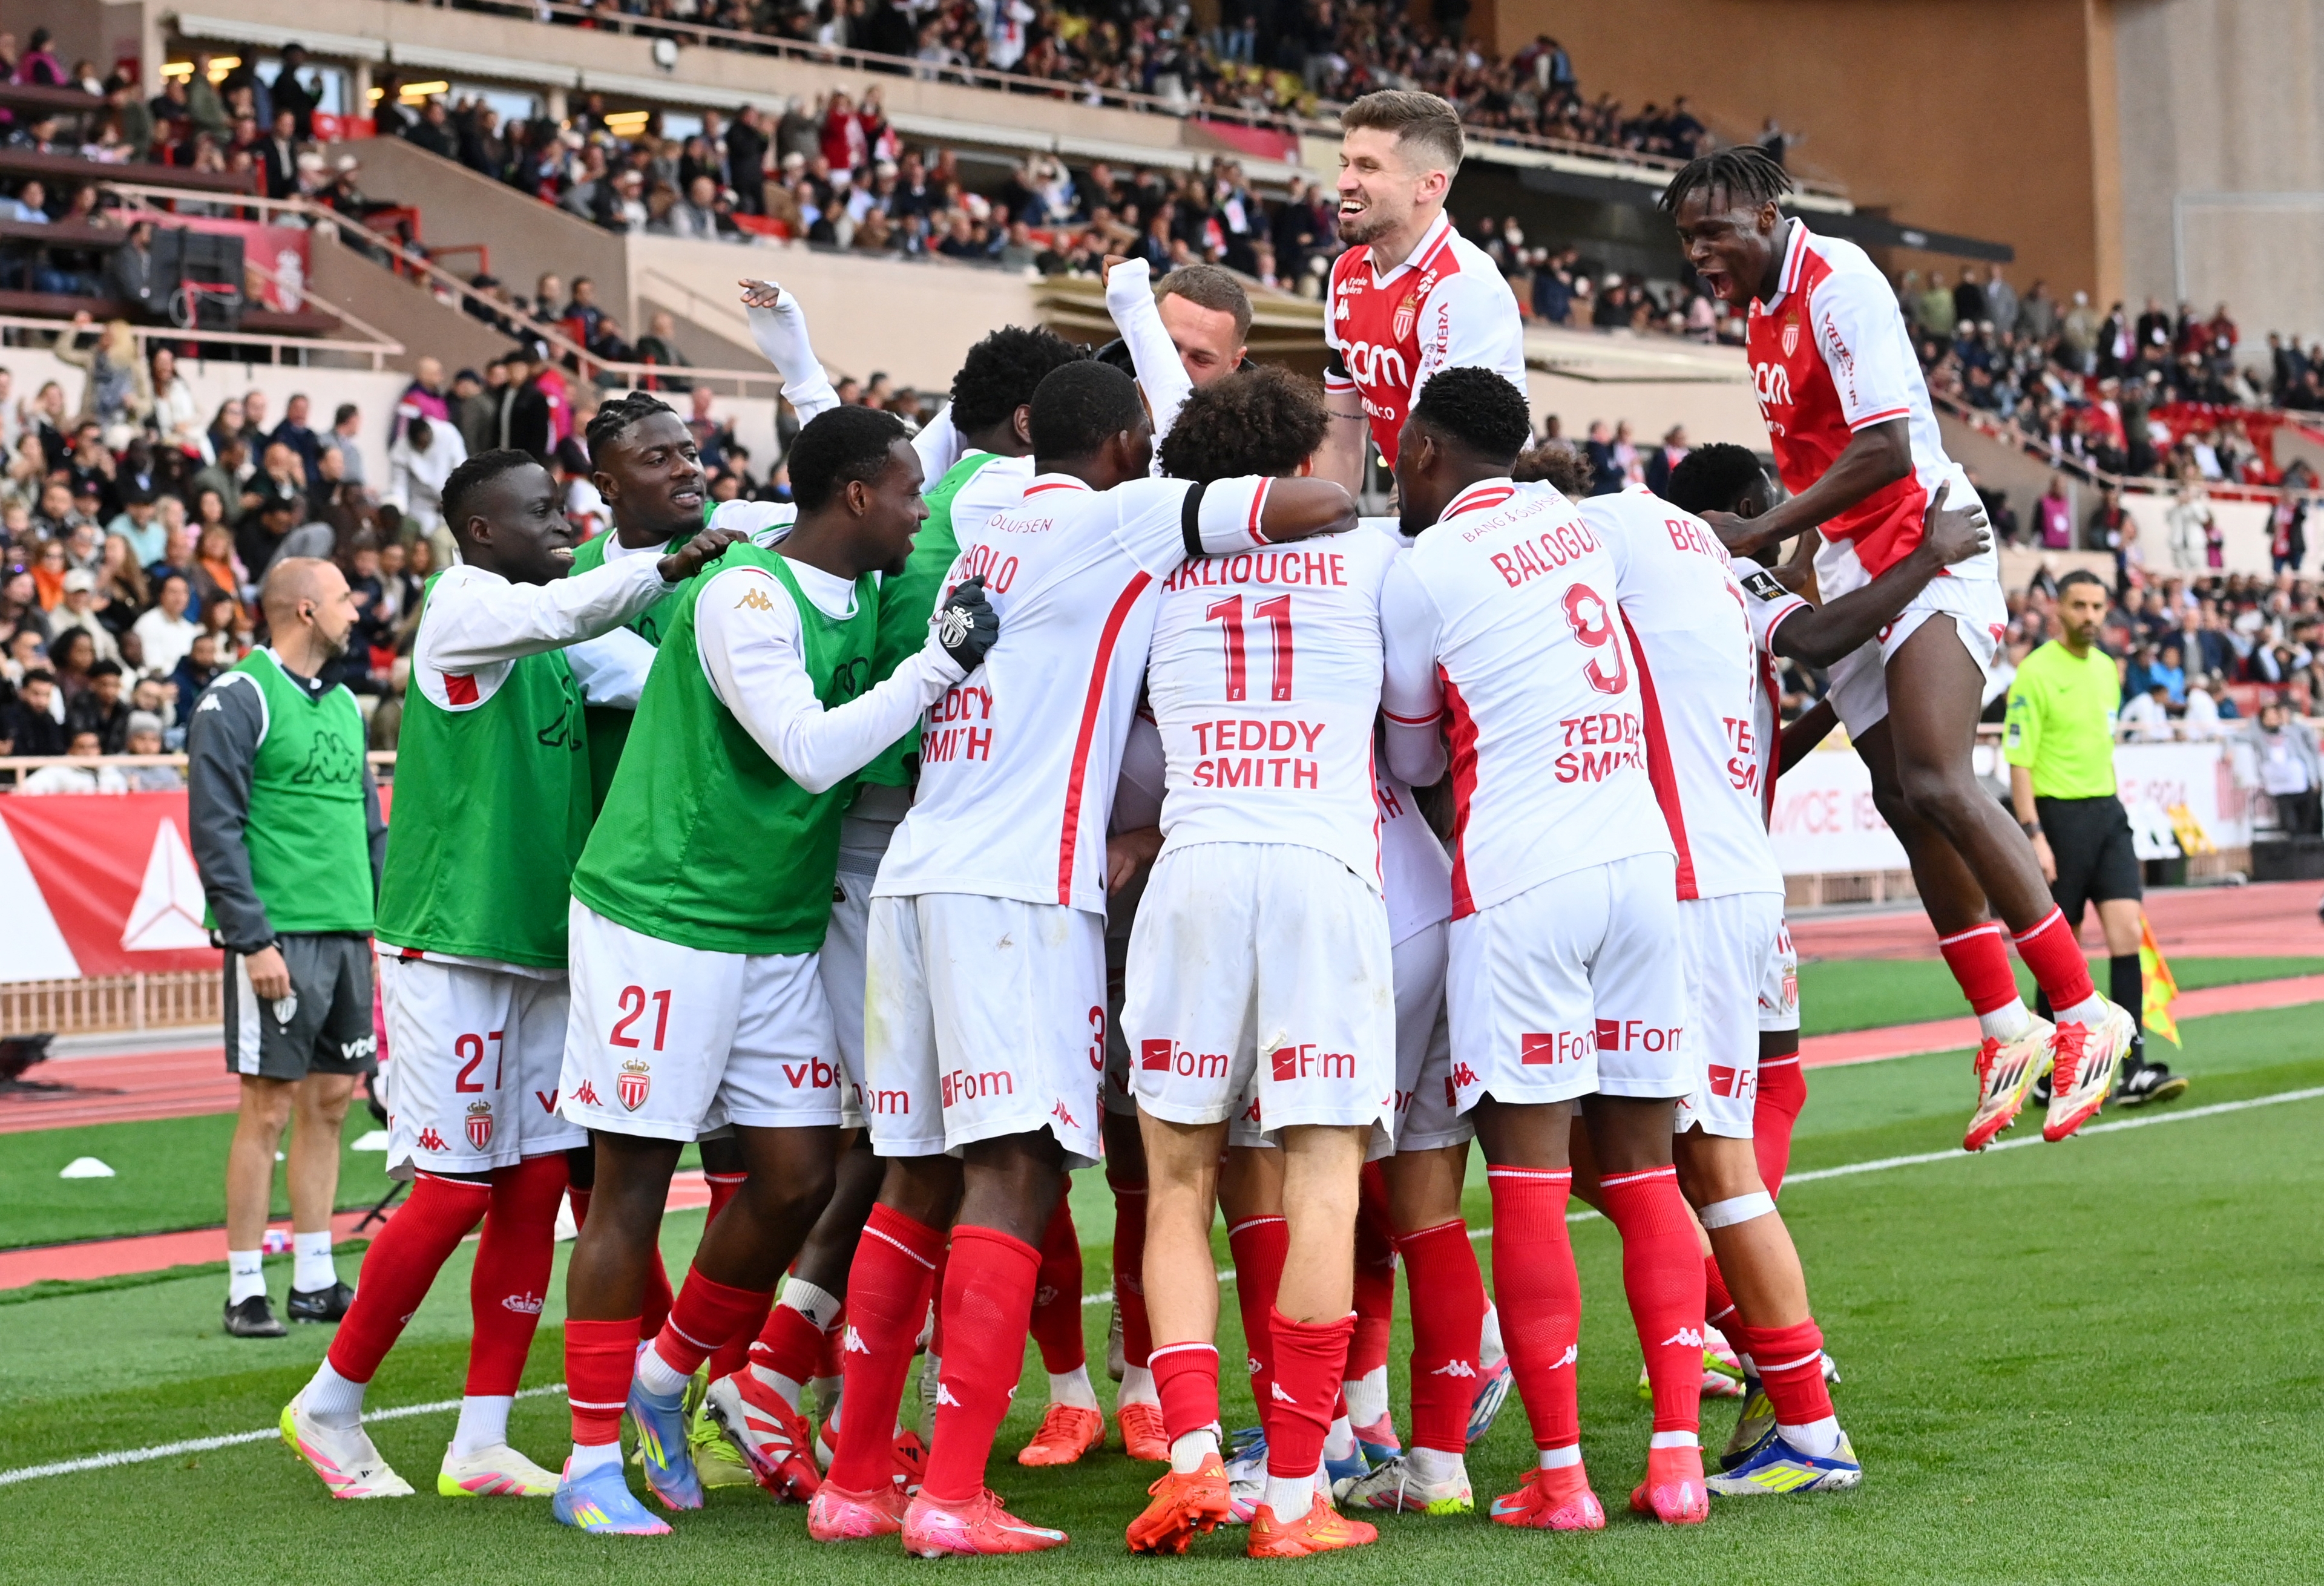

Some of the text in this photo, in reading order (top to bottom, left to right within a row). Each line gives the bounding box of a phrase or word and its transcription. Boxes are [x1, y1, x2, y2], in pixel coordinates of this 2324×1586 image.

[1748, 362, 1794, 418] pm
[1462, 517, 1506, 542] BANG
[1505, 511, 1517, 522] &
[1489, 517, 1601, 588] BALOGU
[1161, 552, 1348, 594] AKLIOUCHE
[1206, 594, 1293, 702] 11
[1561, 583, 1628, 695] 9
[925, 686, 993, 723] EDDY
[1192, 719, 1325, 756] TEDDY
[1560, 712, 1641, 747] TEDD
[1192, 757, 1318, 789] SMITH
[609, 985, 672, 1051] 21
[455, 1031, 504, 1093] 27
[1299, 1044, 1355, 1079] Fm
[953, 1069, 1013, 1103] Fom
